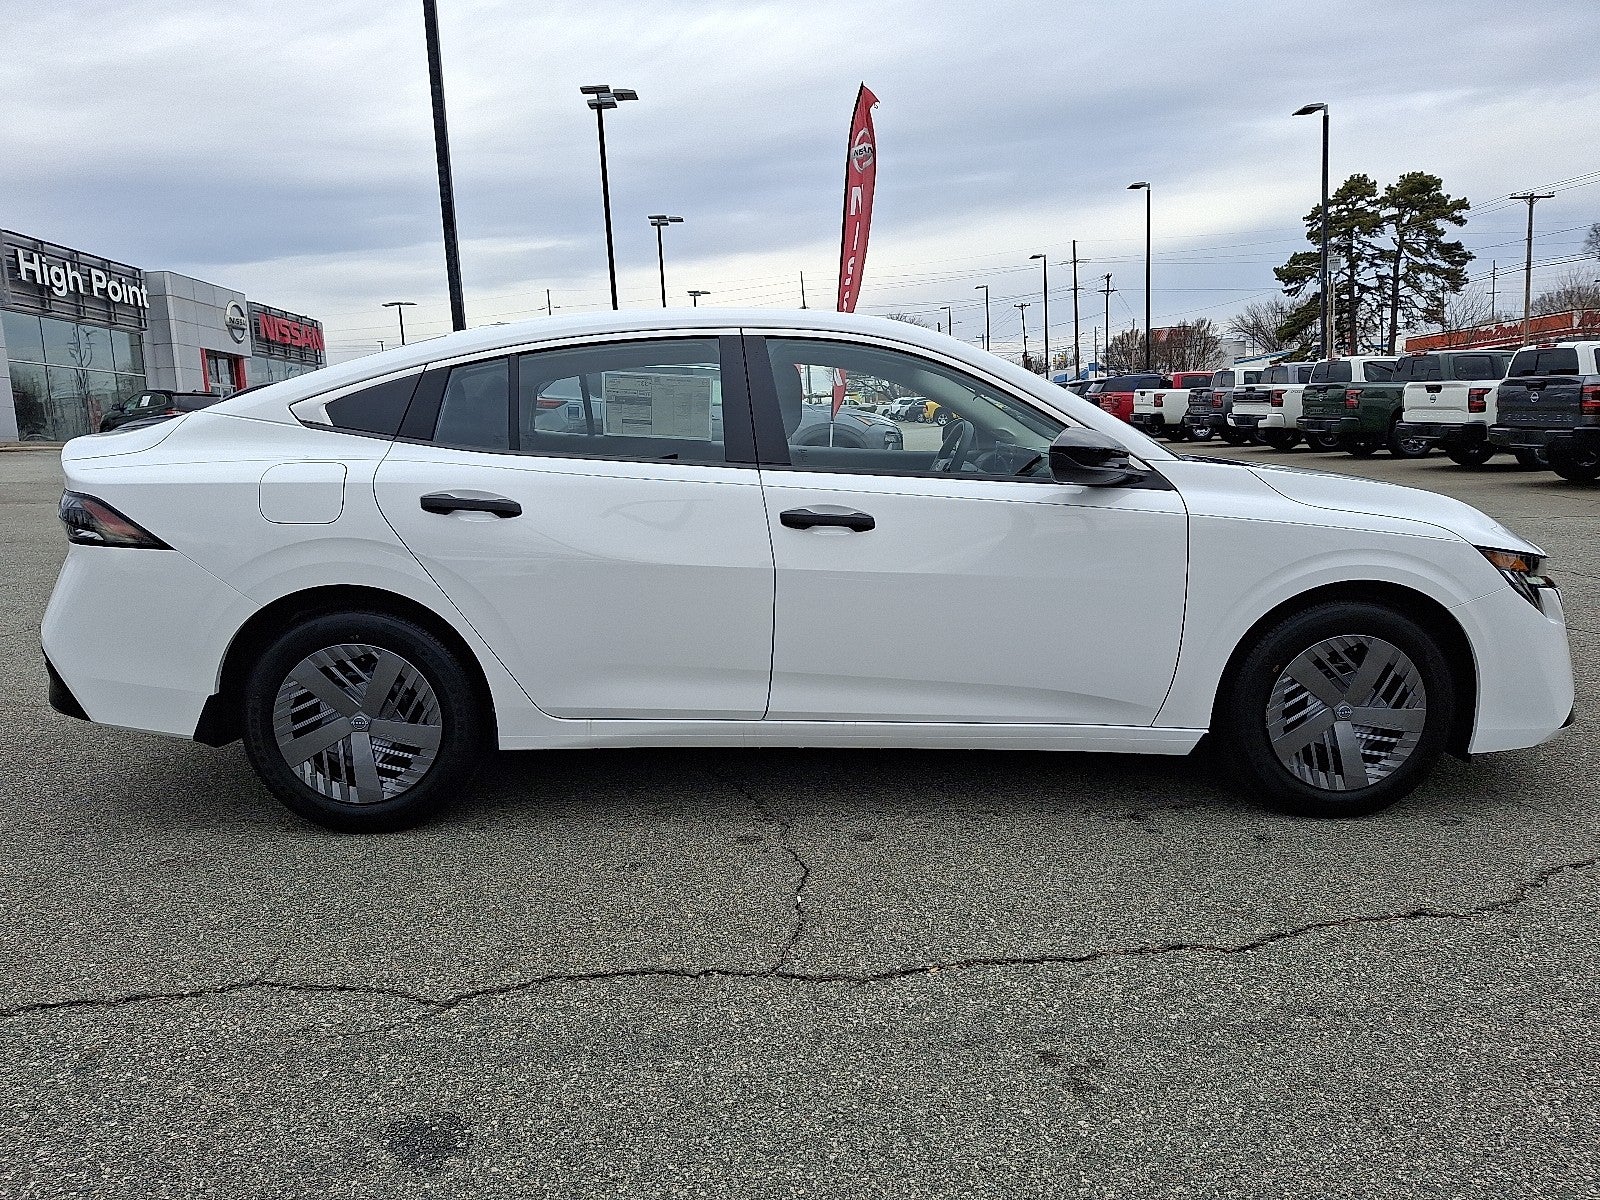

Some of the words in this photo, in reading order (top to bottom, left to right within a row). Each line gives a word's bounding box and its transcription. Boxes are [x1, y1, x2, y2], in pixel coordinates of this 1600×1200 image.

[17, 249, 84, 297] High
[90, 268, 149, 308] Point
[259, 313, 324, 352] NISSAN
